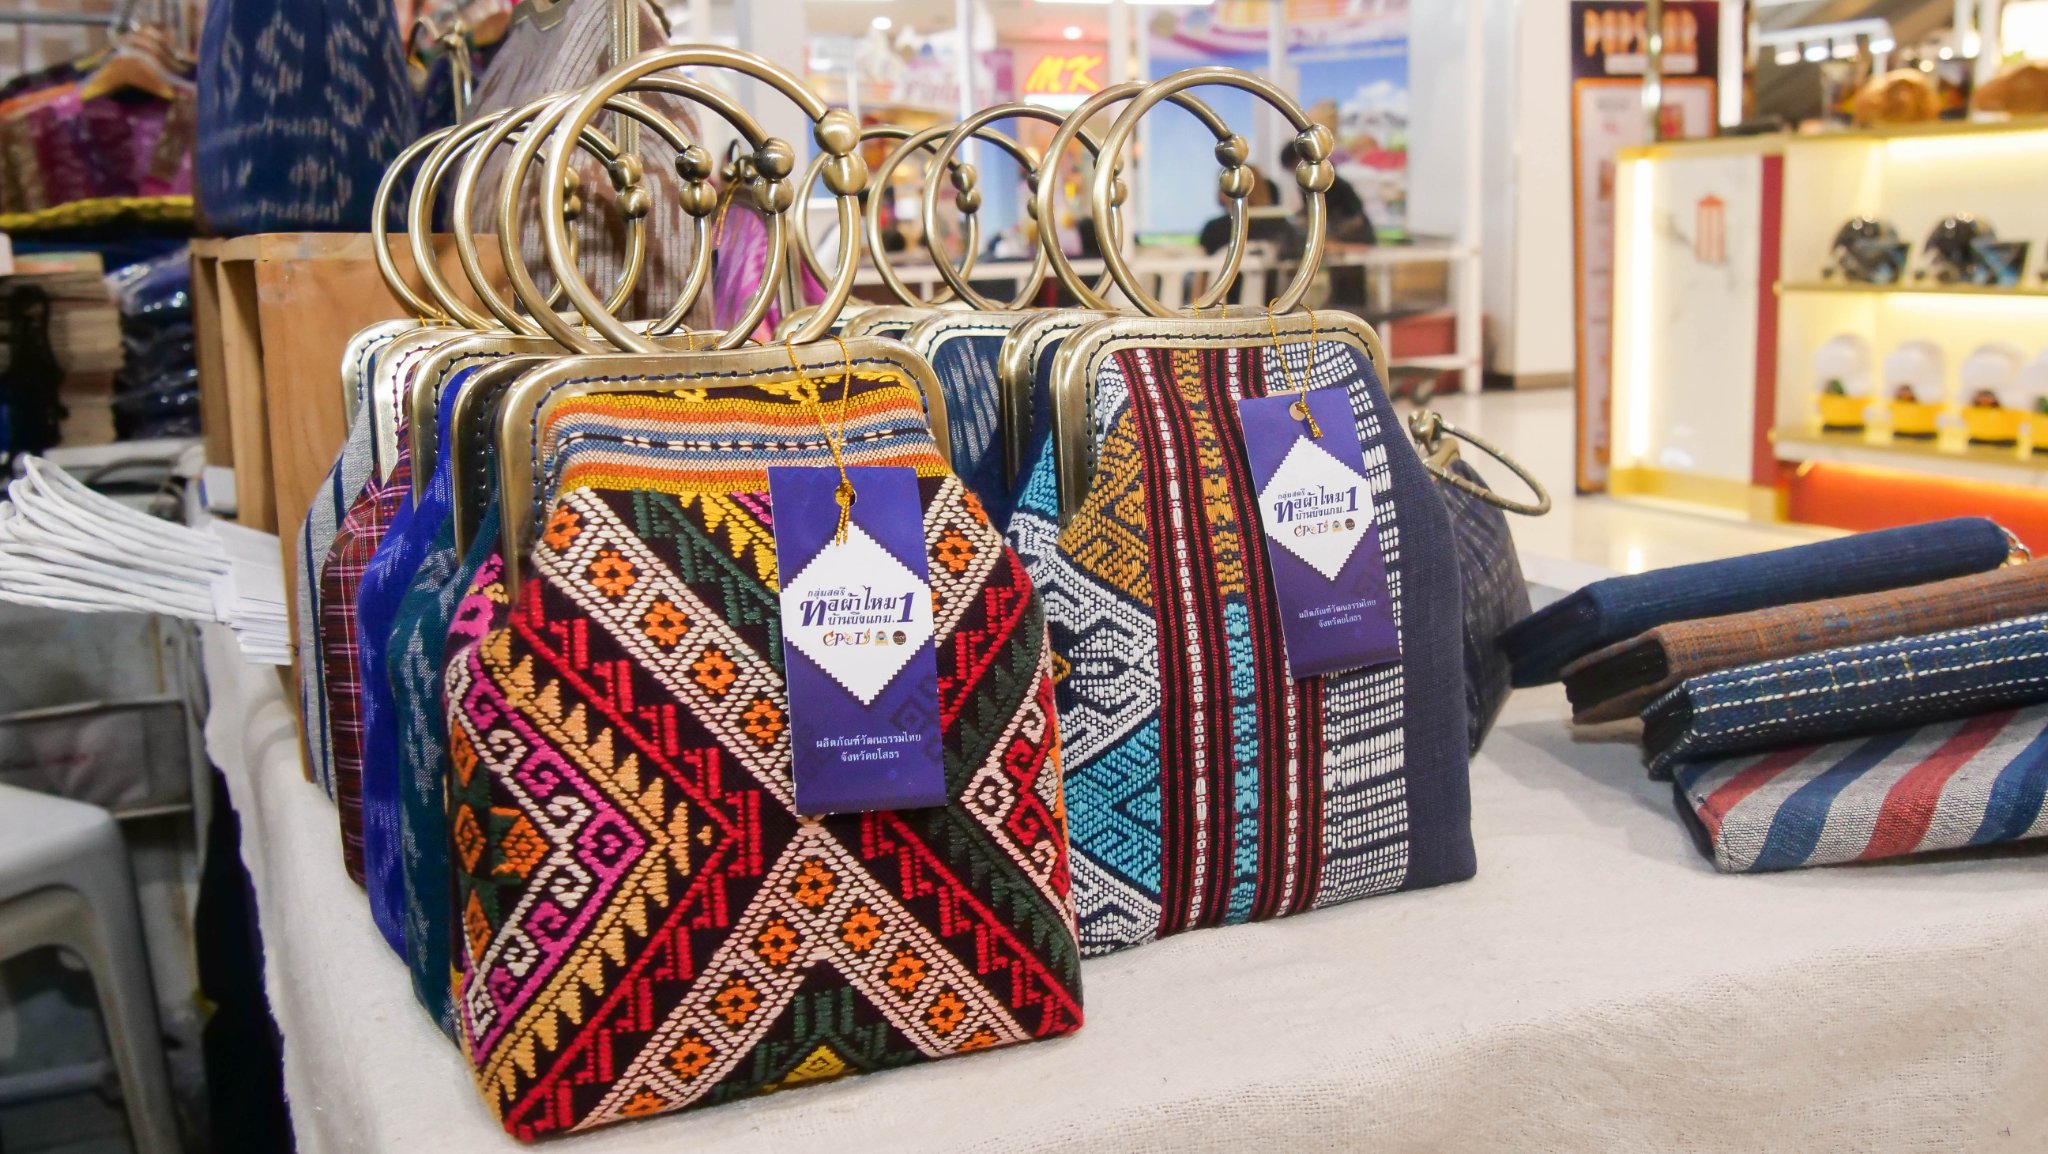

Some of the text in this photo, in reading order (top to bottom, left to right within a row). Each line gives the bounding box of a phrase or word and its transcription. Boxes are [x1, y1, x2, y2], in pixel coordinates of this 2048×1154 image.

[1024, 53, 1103, 93] MK
[1273, 484, 1359, 523] ทอผ้าไหม 1
[799, 585, 915, 627] ทอผ้าไหม 1
[807, 586, 846, 600] กลุ่มสตรี
[815, 731, 922, 748] ผลิตภัณฑ์วัฒนธรรมไทย
[840, 748, 900, 762] จังหวัดยโสธร
